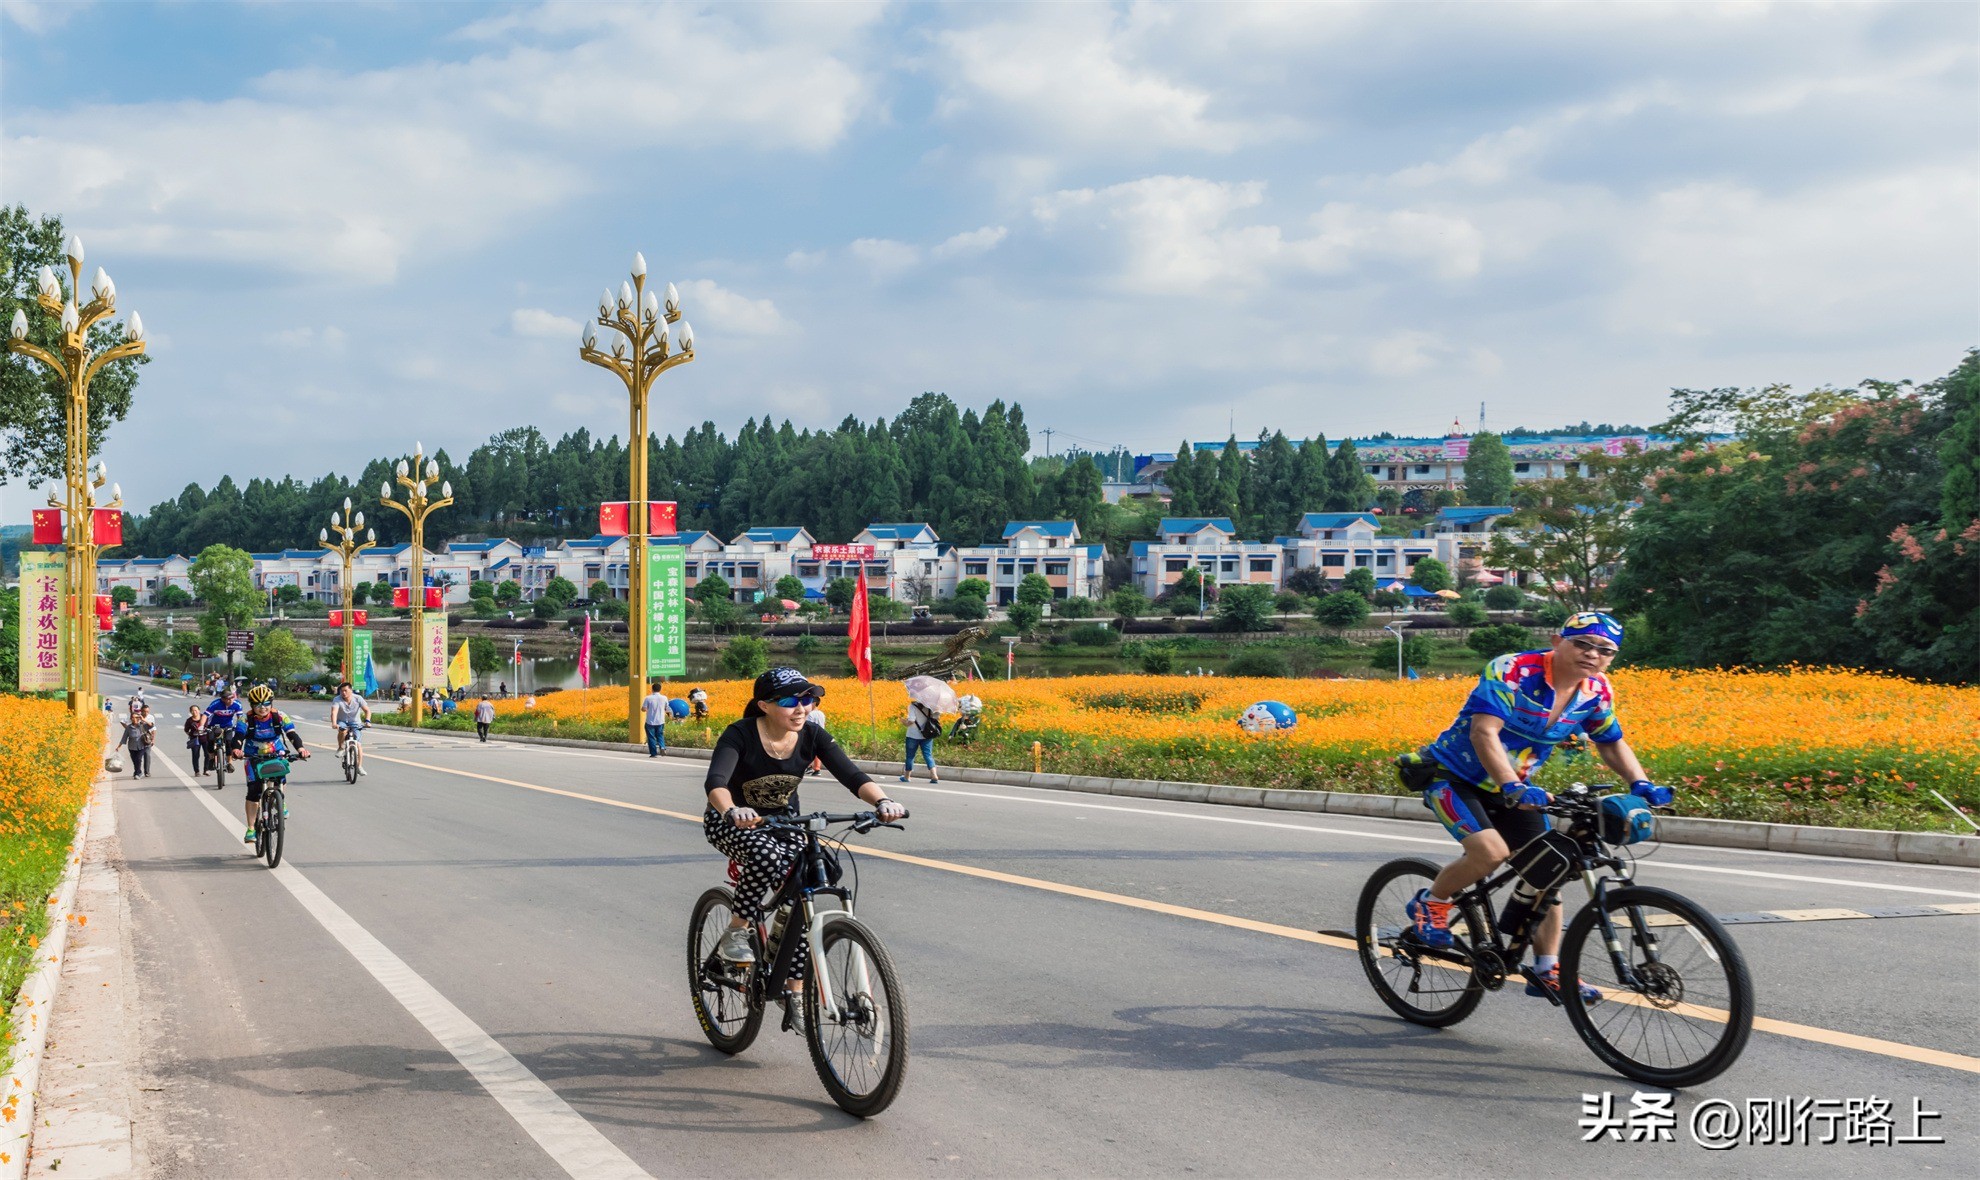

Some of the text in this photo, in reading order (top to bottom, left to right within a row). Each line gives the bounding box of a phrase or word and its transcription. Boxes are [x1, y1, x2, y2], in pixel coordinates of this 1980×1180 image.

[814, 545, 866, 555] 农家乐土菜馆
[36, 575, 59, 669] 宝森欢迎您
[653, 580, 665, 643] 中国柠檬小镇
[432, 626, 444, 677] 宝森欢迎您
